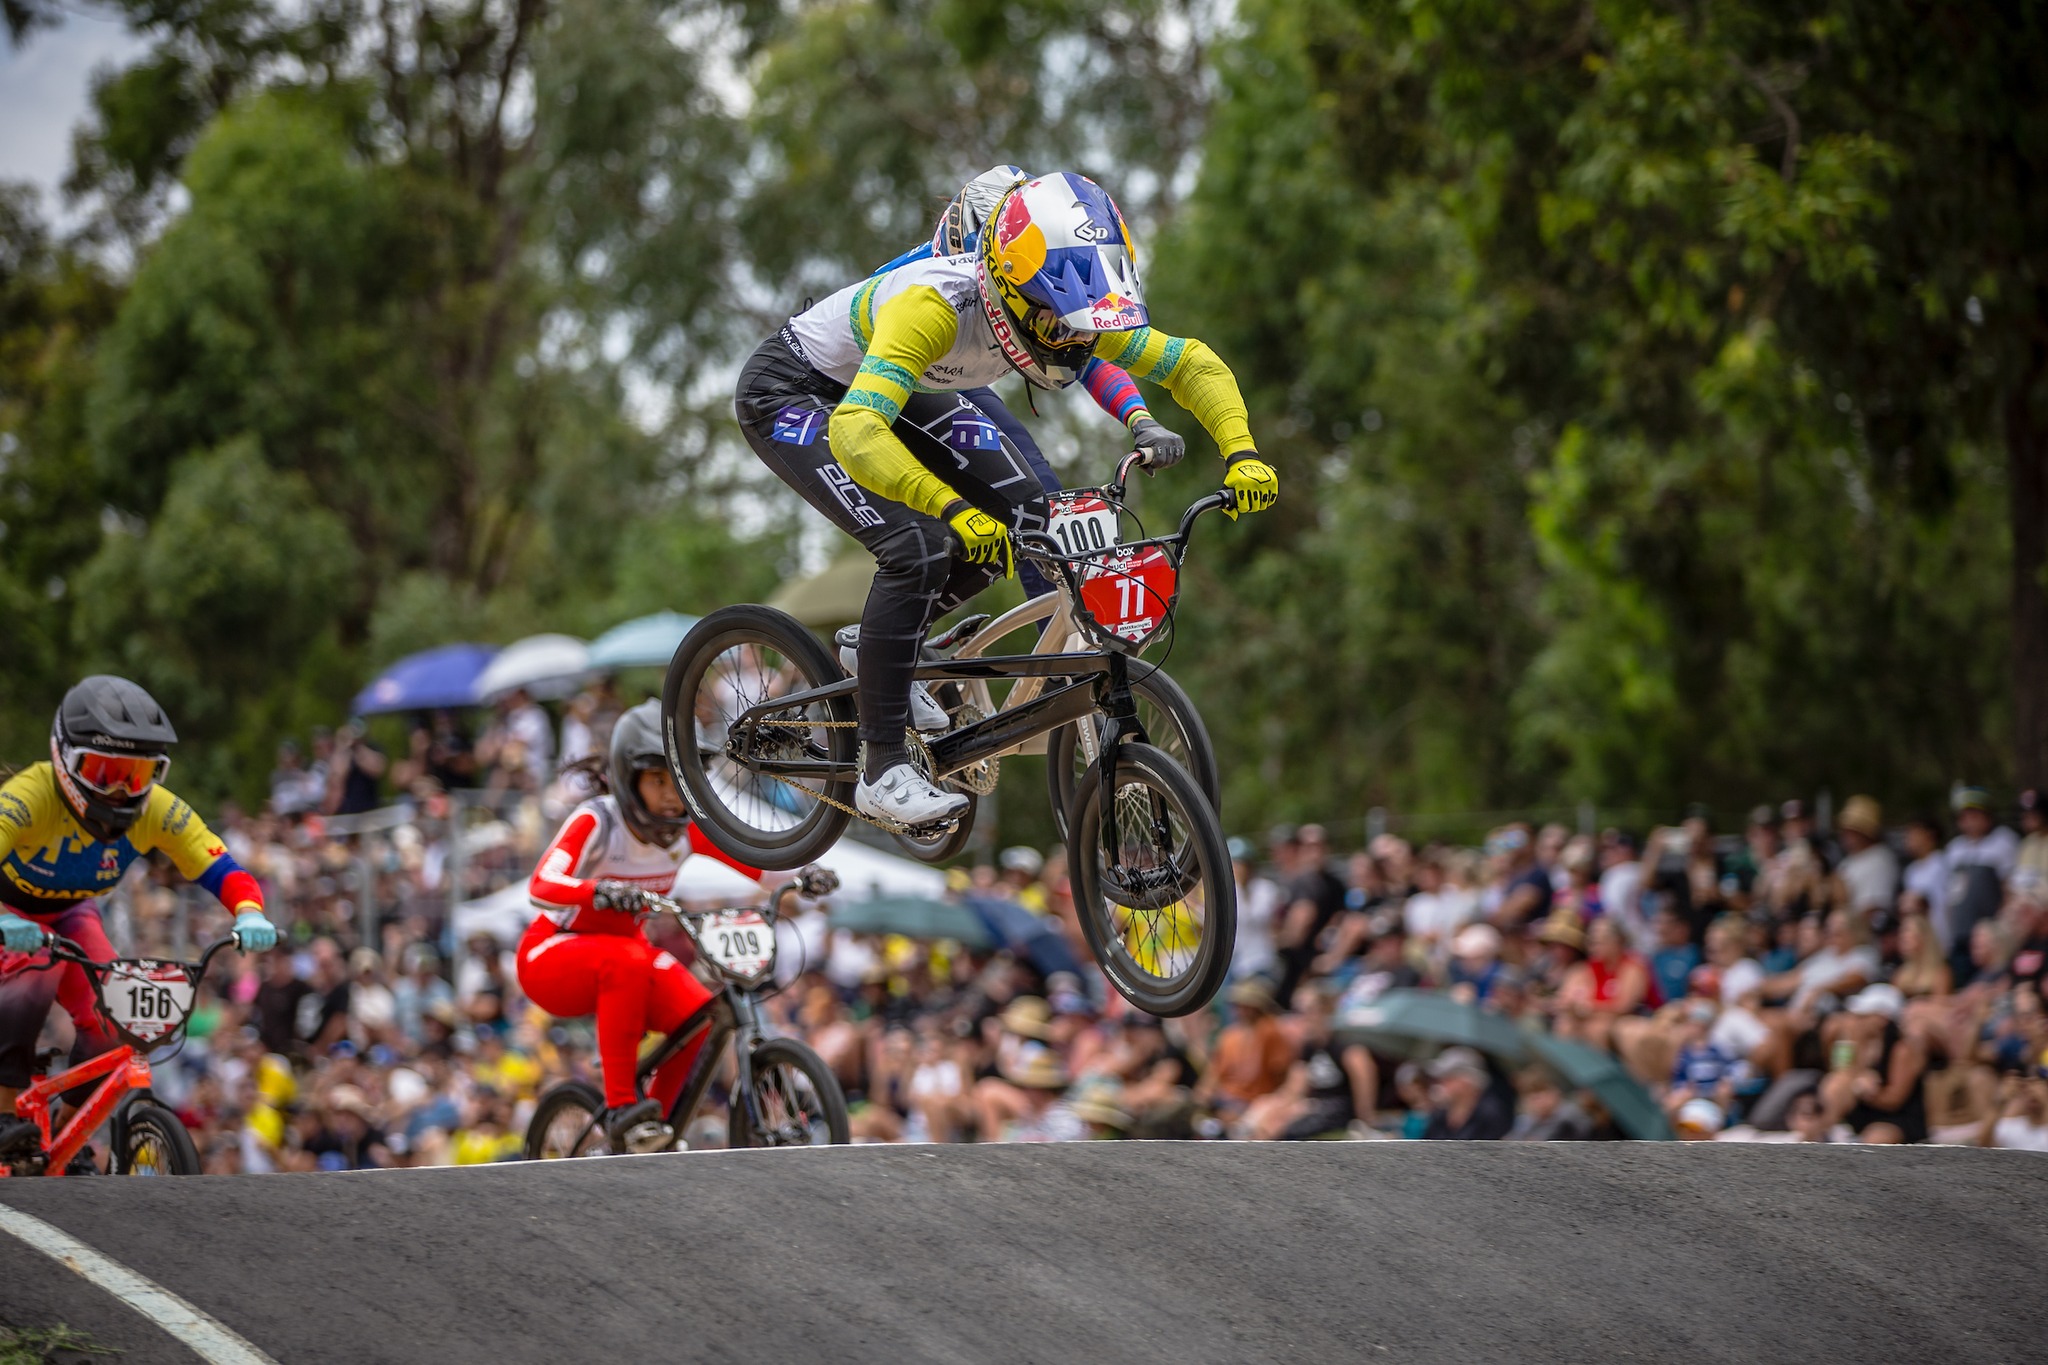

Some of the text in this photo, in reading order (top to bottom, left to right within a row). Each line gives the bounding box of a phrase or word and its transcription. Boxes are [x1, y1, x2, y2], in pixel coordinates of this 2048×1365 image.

[1073, 219, 1108, 242] 6D
[983, 224, 1018, 300] OAKLEY
[976, 262, 1036, 370] Red Bull
[1092, 312, 1143, 329] Red Bull
[1056, 517, 1106, 556] 100
[1116, 546, 1135, 557] box
[1113, 562, 1126, 570] UCI
[1115, 575, 1145, 619] 77
[1080, 715, 1096, 761] SWER
[719, 930, 760, 958] 209
[126, 986, 172, 1019] 156
